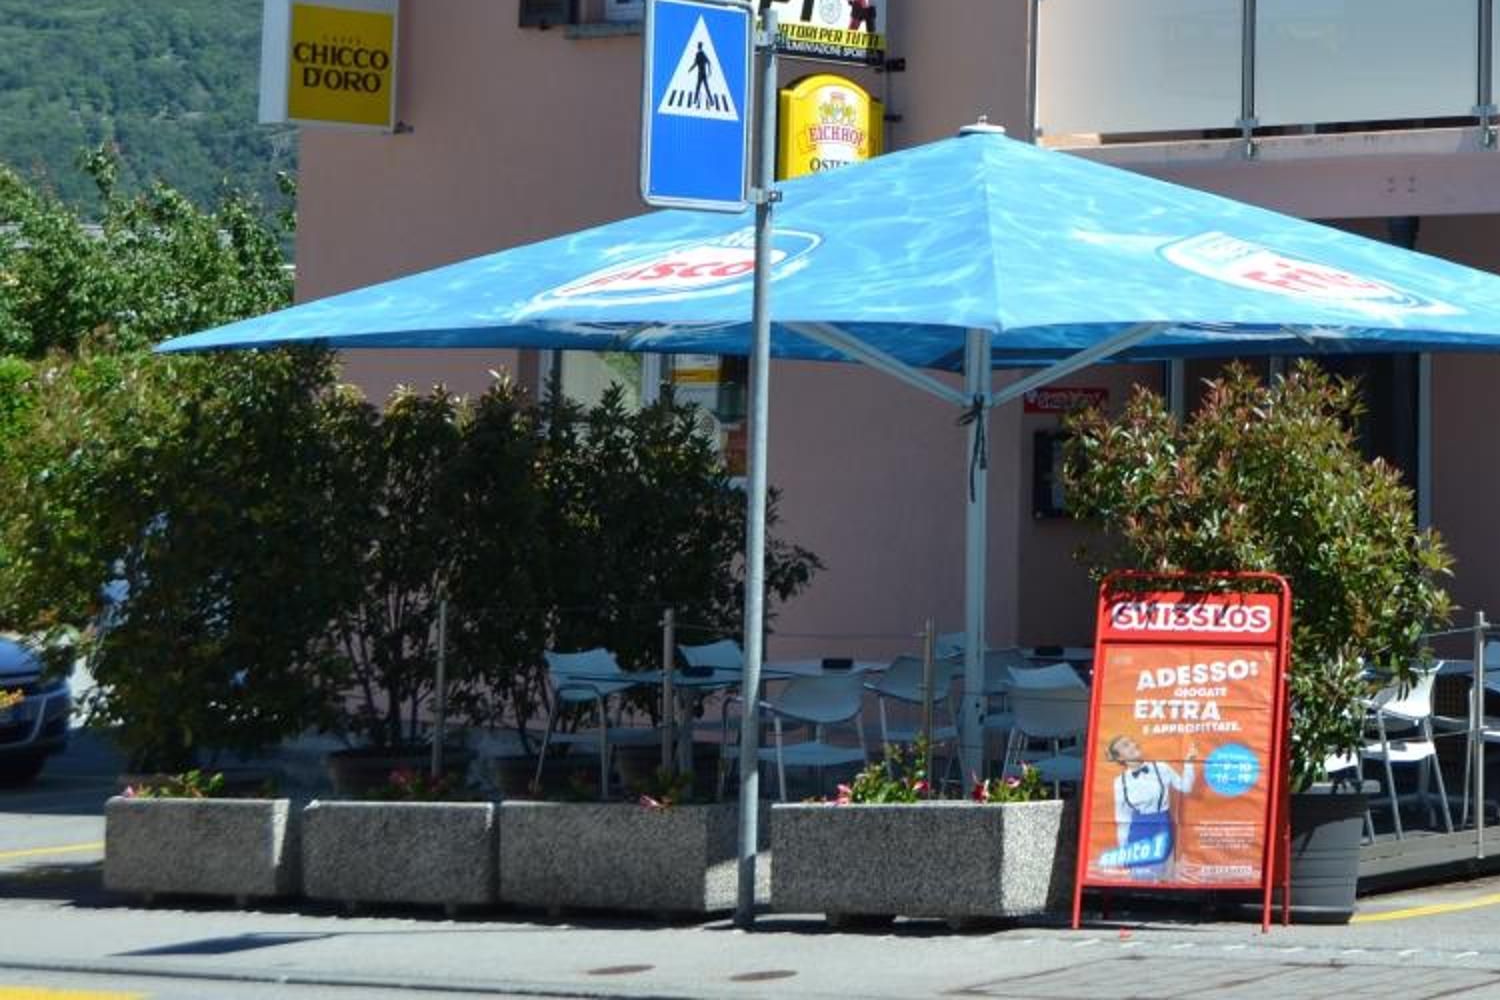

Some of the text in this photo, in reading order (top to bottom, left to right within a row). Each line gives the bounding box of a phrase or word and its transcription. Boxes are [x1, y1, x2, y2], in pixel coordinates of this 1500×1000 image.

[294, 41, 389, 72] CHICCO
[303, 66, 381, 93] D'ORO
[1112, 603, 1270, 631] SWISSLOS
[1136, 658, 1259, 691] ADESSO:
[1133, 698, 1221, 721] EXTRA
